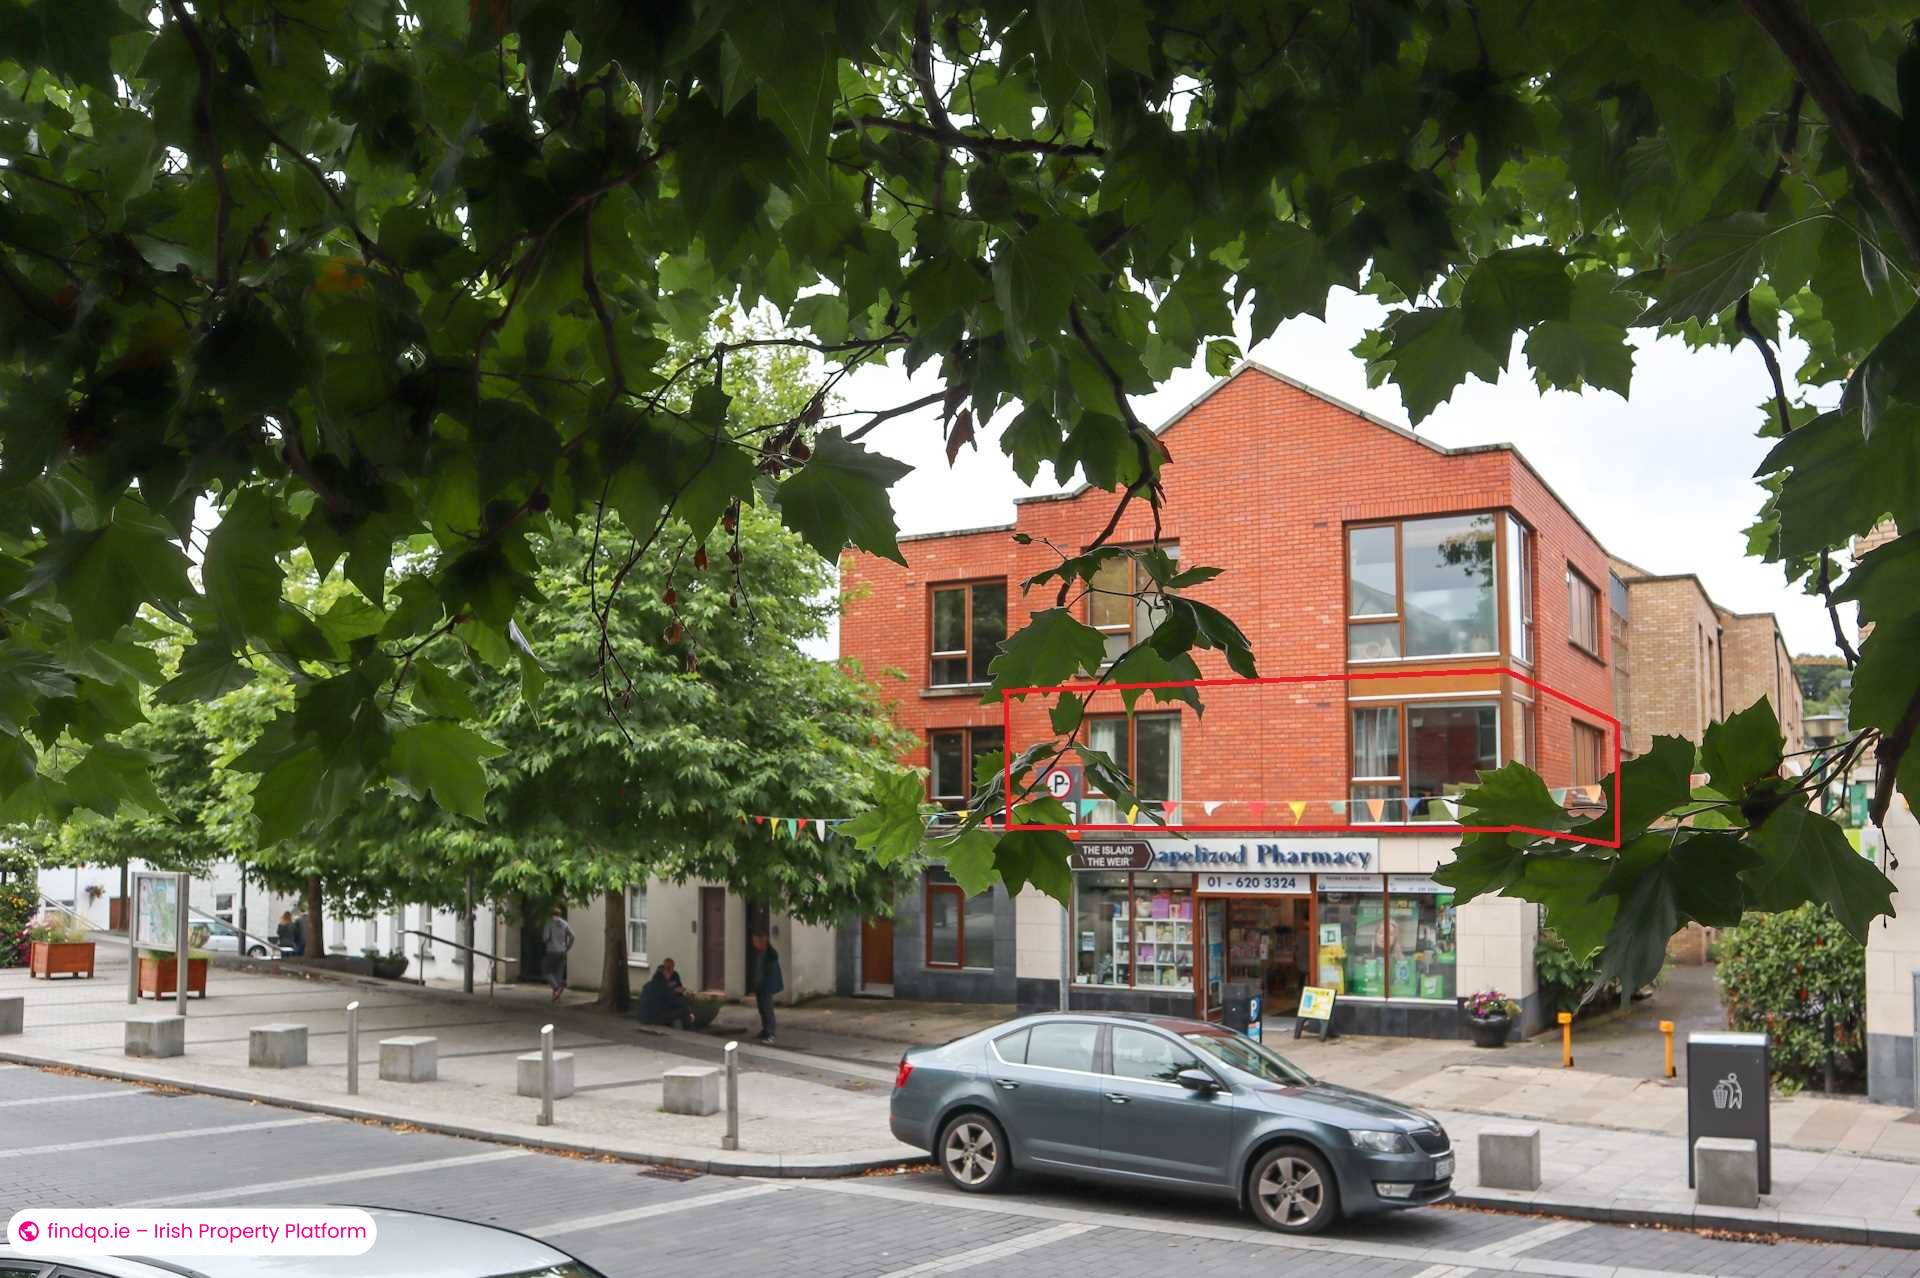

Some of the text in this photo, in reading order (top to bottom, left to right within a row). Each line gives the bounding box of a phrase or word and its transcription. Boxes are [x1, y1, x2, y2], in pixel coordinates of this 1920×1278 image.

[1055, 775, 1065, 793] P
[1083, 846, 1134, 855] THE ISLAND
[1088, 858, 1130, 866] THE WEIR
[1153, 844, 1372, 870] apelizod Pharmacy
[1208, 878, 1221, 888] 01
[1236, 877, 1260, 888] 620
[1264, 877, 1296, 888] 3324
